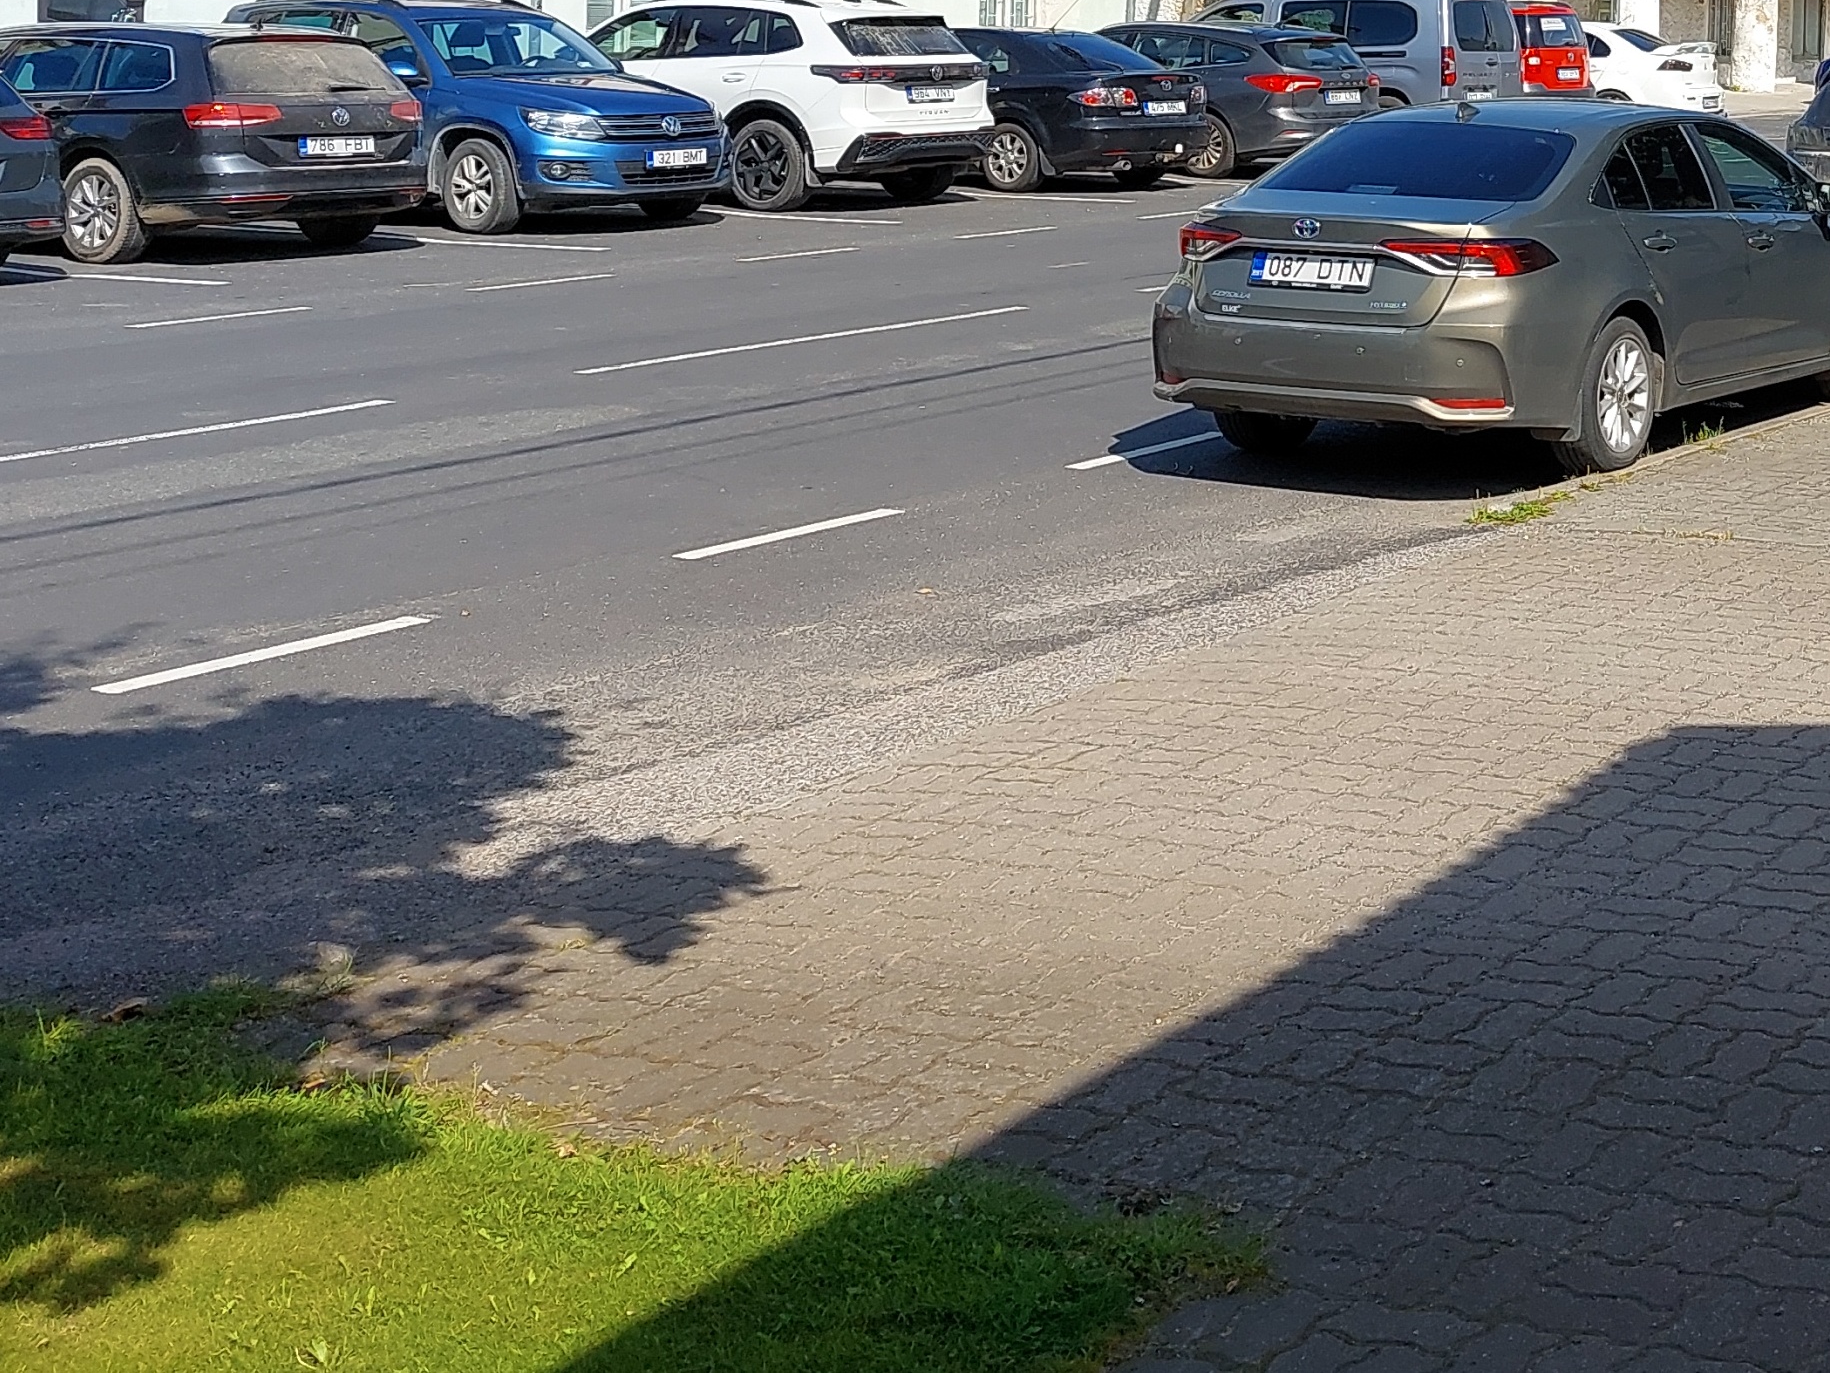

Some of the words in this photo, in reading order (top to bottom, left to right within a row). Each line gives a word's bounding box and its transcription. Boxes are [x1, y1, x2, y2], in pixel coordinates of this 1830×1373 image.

[913, 87, 930, 99] 964
[310, 138, 335, 152] 786
[345, 137, 371, 151] FBT
[657, 152, 676, 165] 321
[682, 150, 704, 163] BMT
[1268, 255, 1308, 278] 087
[1316, 258, 1367, 282] DTN
